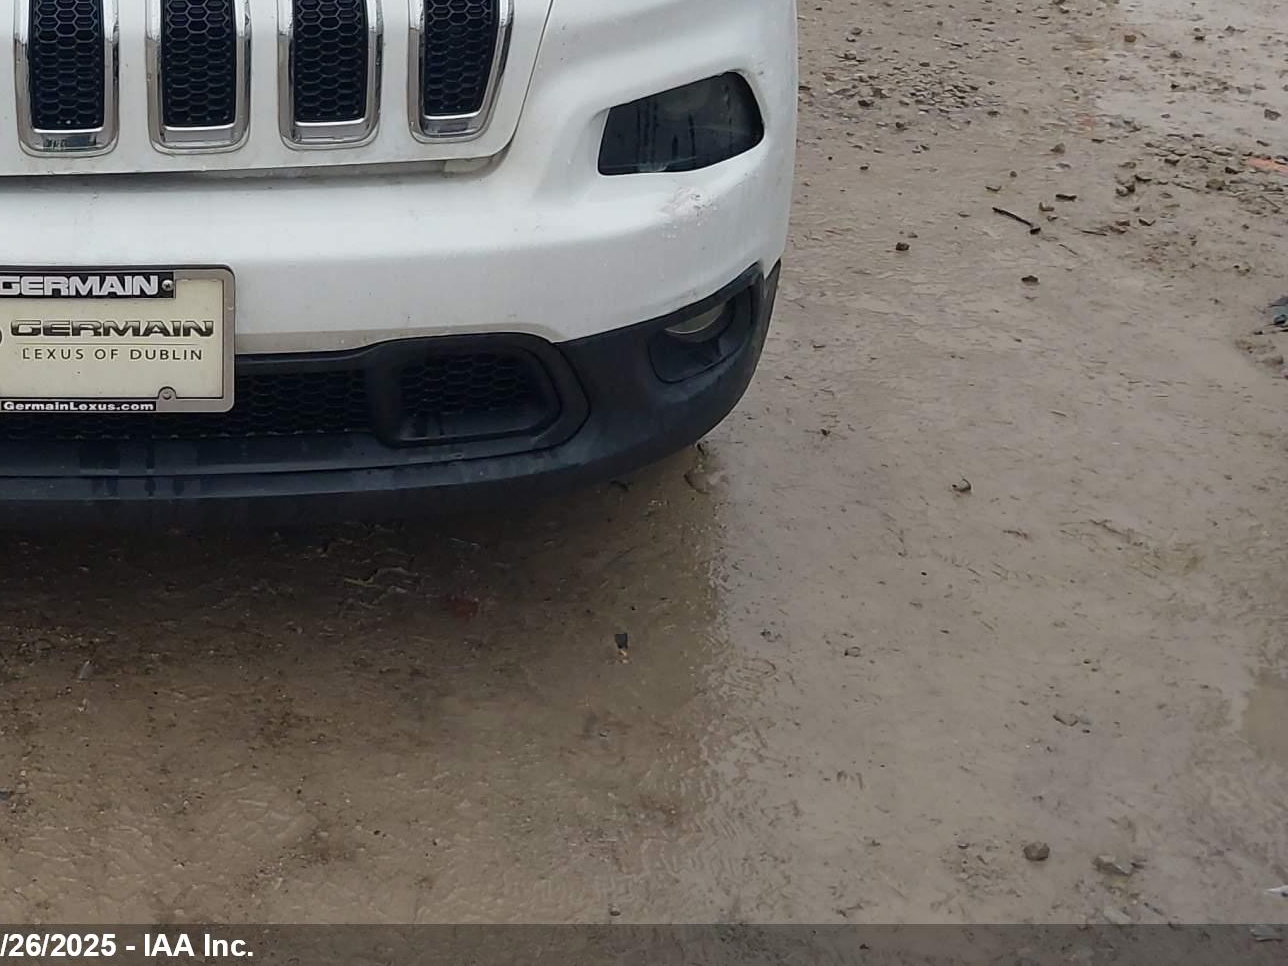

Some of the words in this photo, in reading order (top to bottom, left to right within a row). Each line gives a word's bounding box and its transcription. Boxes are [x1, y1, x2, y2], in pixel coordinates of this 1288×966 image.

[10, 319, 214, 338] GERMAIN
[22, 347, 85, 361] LEXUS
[94, 348, 120, 361] OF
[129, 348, 203, 361] DUBLIN
[3, 400, 155, 412] GermainLexus.com
